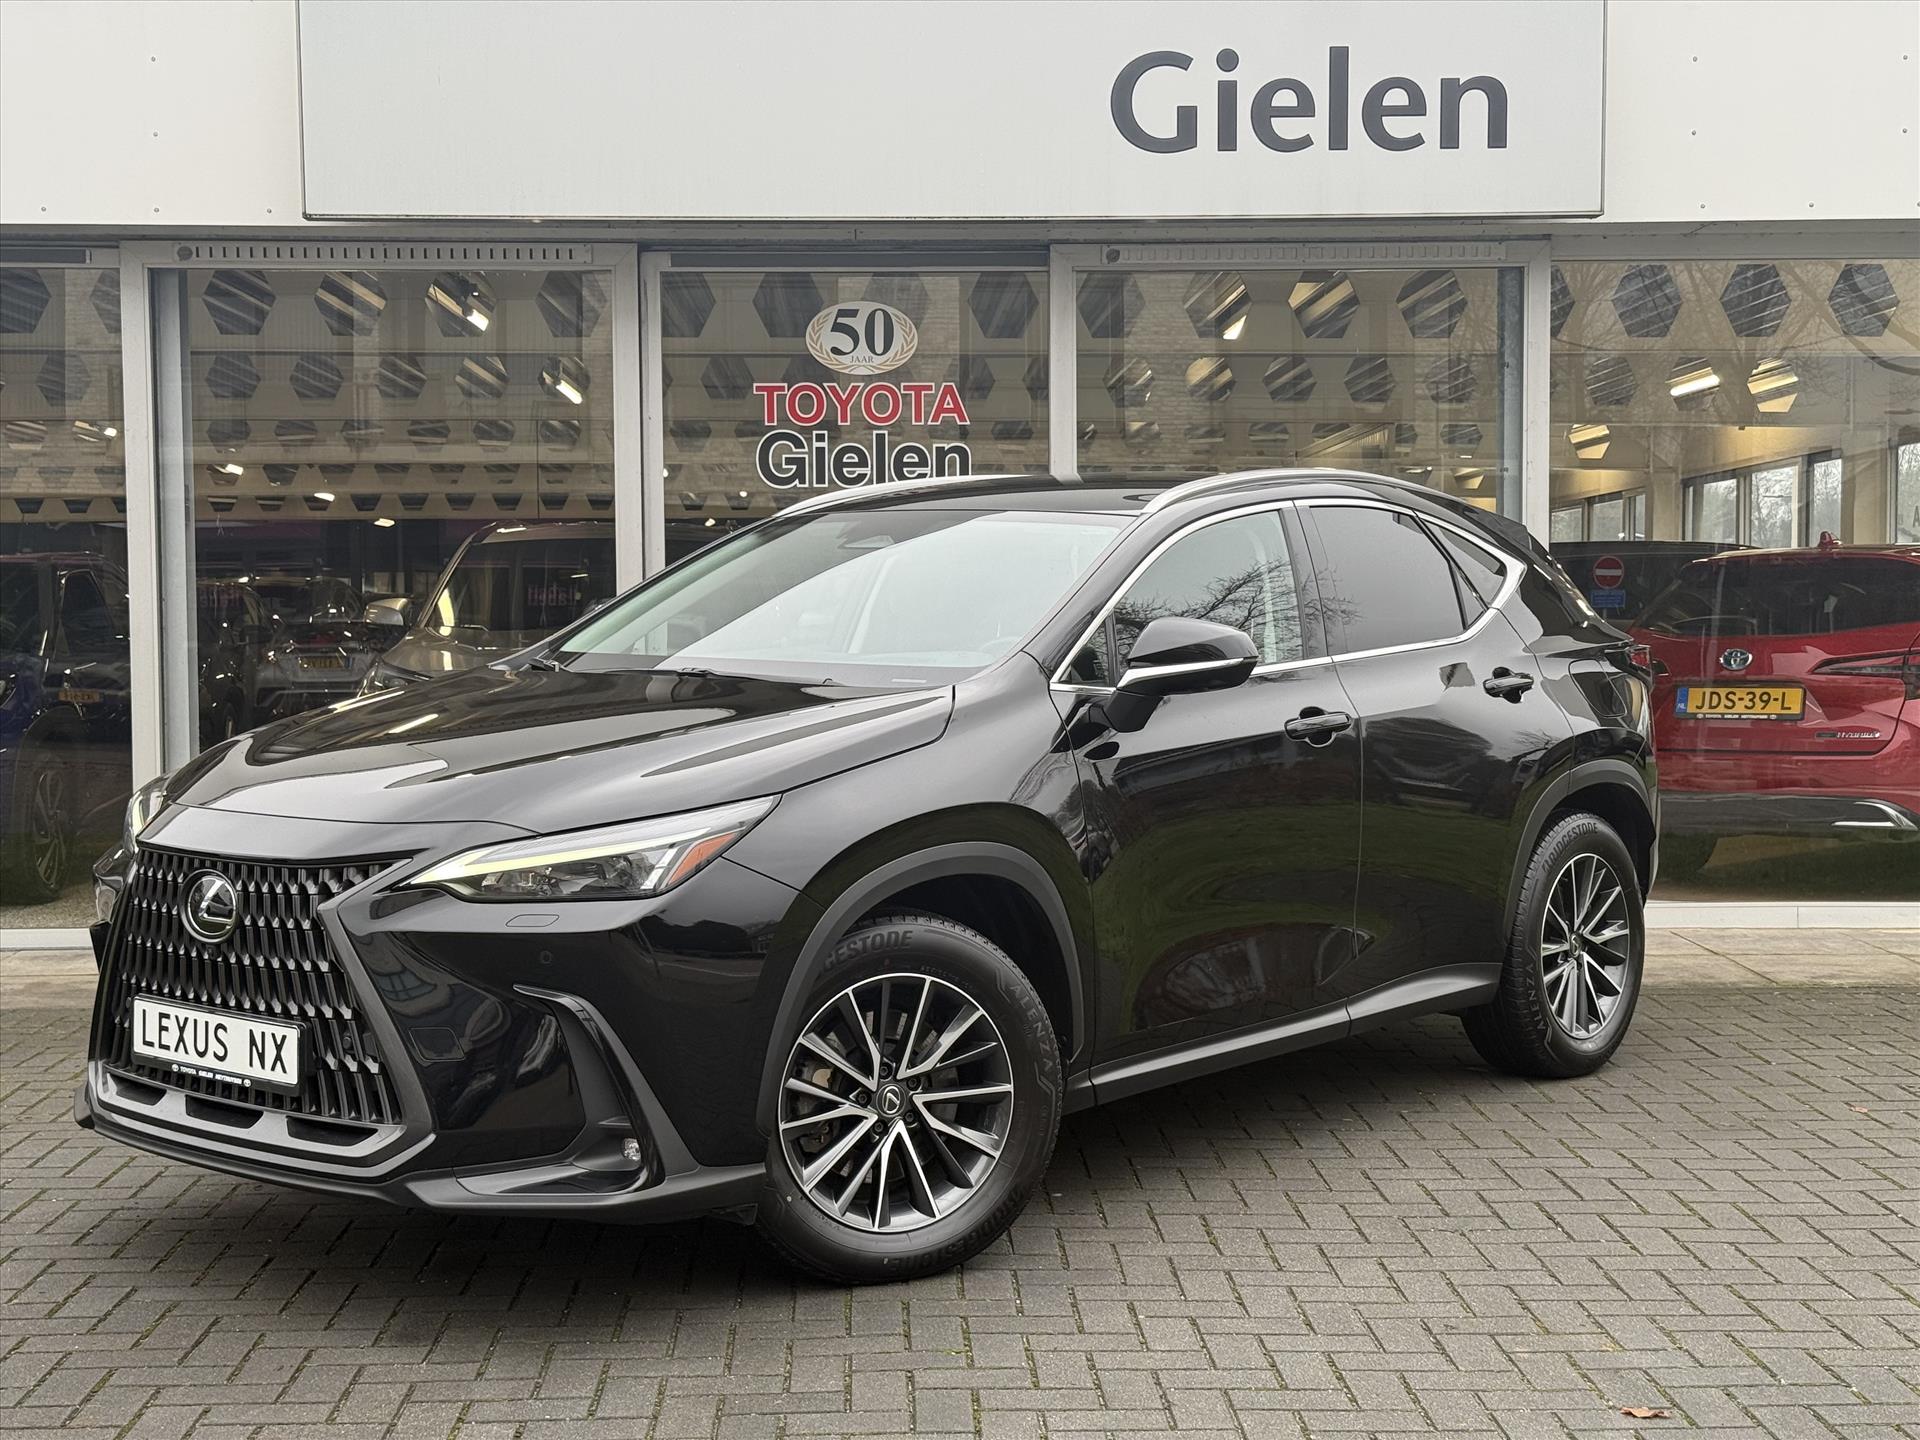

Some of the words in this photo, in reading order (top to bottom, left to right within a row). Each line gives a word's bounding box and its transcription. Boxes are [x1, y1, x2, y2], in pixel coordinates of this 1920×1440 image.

[1110, 45, 1508, 154] Gielen
[829, 307, 895, 357] 50
[849, 355, 875, 364] JAAR
[753, 382, 971, 426] TOYOTA
[756, 429, 972, 489] Gielen
[1695, 690, 1792, 711] JDS-39-L
[1541, 821, 1599, 873] BRIDGESTONE
[142, 1008, 229, 1063] LEXUS
[249, 1028, 288, 1075] NX
[1010, 984, 1053, 1072] ALENZA
